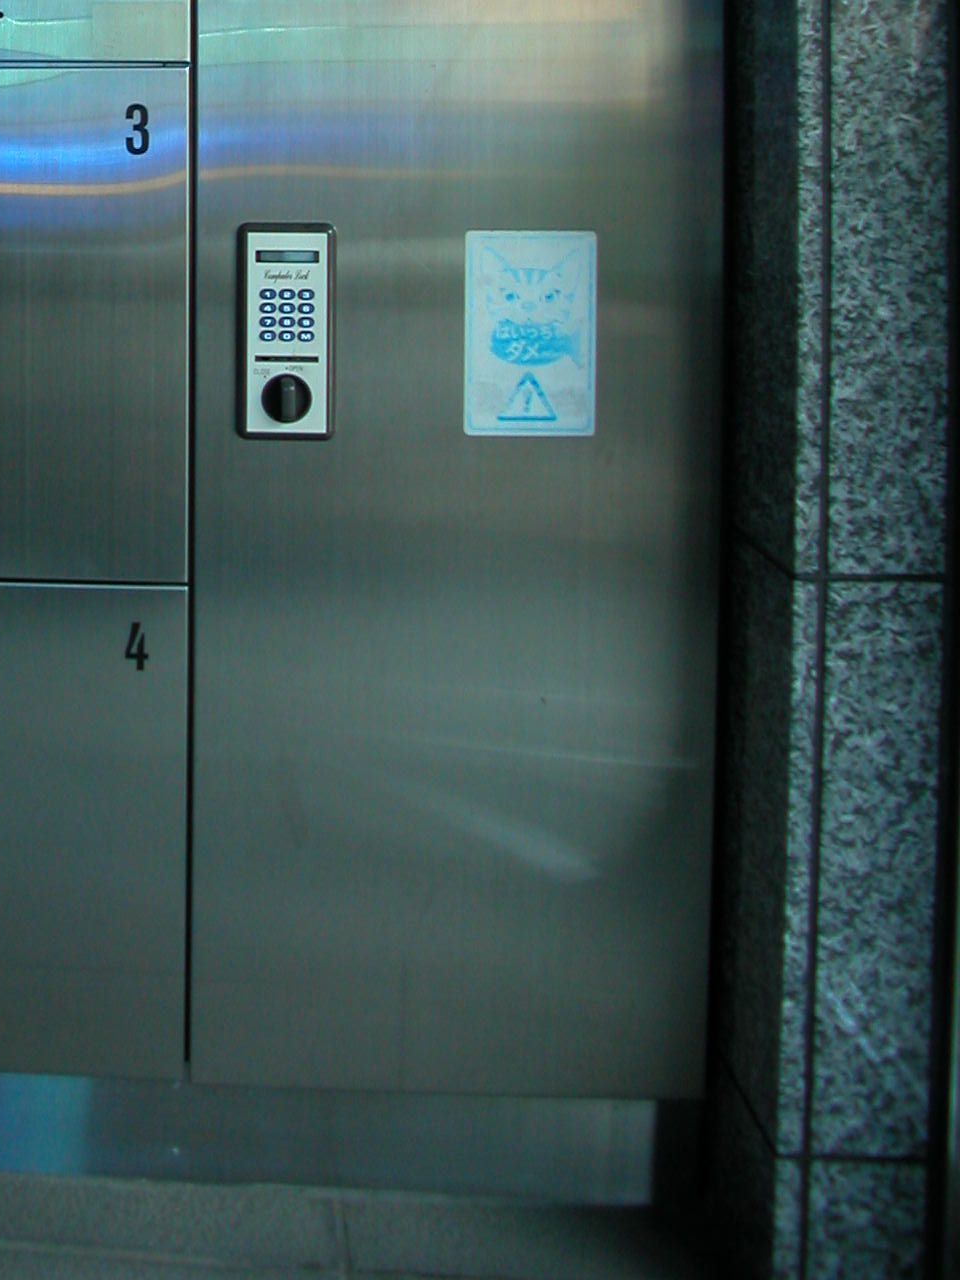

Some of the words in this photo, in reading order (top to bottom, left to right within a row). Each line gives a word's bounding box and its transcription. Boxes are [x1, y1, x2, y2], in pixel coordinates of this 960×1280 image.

[125, 103, 150, 156] 3
[506, 339, 539, 361] ダメ
[124, 622, 150, 671] 4
